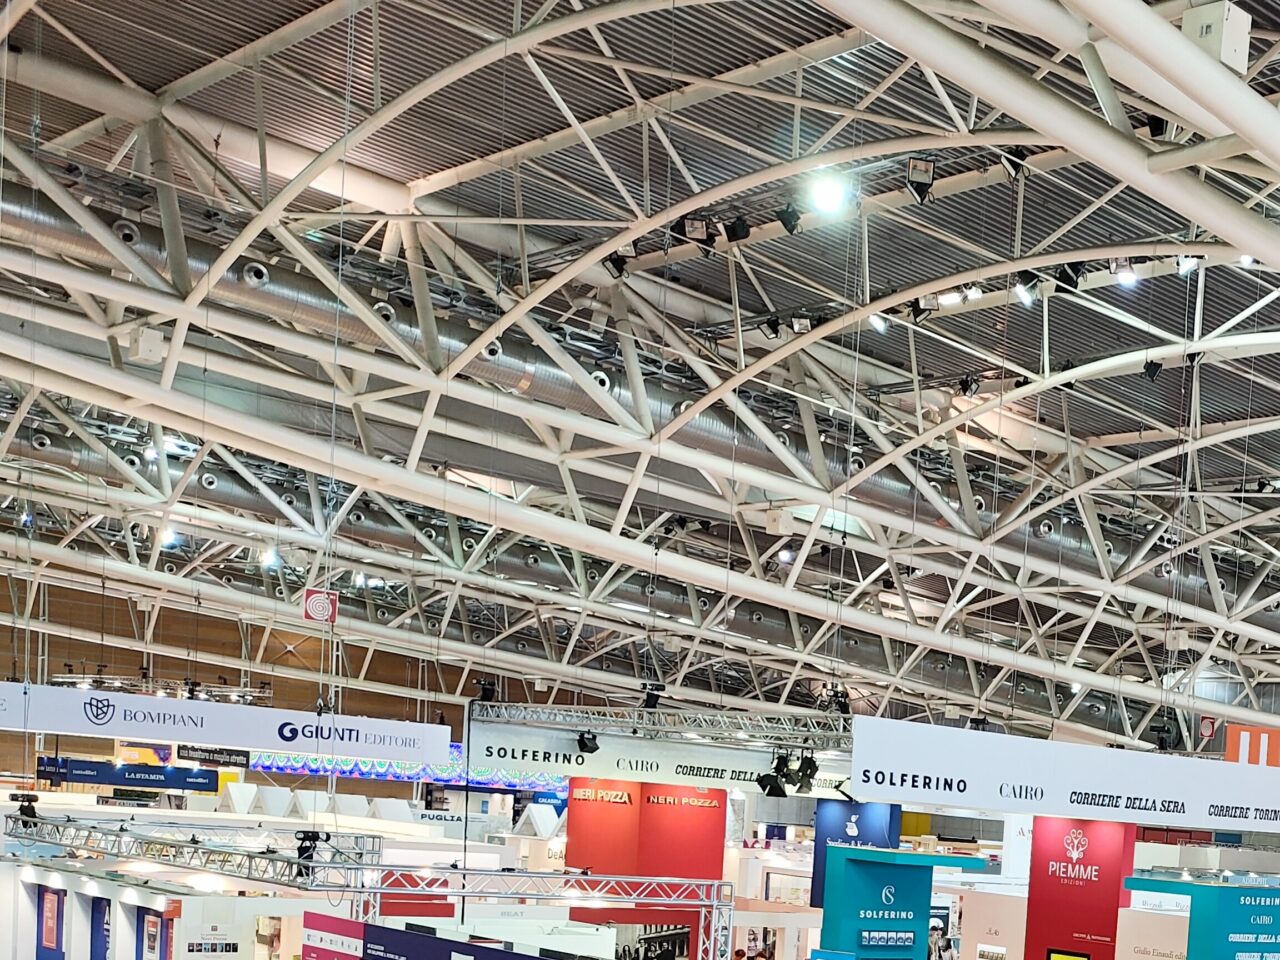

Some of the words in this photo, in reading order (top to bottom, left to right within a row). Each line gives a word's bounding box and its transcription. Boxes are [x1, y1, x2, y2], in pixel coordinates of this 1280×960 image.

[123, 708, 205, 729] BOMPIANI
[301, 724, 360, 743] GIUNTI
[364, 732, 421, 750] EDITORE
[485, 745, 585, 766] SOLFERINO
[616, 757, 660, 773] CAIRO
[675, 764, 726, 781] CORRIERE
[598, 790, 629, 803] POZZA
[862, 769, 967, 793] SOLFERINO
[999, 782, 1044, 802] CAIRO
[1070, 791, 1121, 809] CORRIERE
[1124, 796, 1156, 812] DELLA
[1160, 800, 1186, 814] SERA
[1208, 804, 1250, 819] CORRIERE
[650, 795, 679, 805] NERI
[681, 797, 720, 808] POZZA
[420, 812, 463, 823] PUGLIA
[1048, 861, 1100, 881] PIEMME
[1060, 879, 1086, 887] EDIZIONI
[859, 909, 914, 920] SOLFERINO
[1250, 915, 1273, 924] CAIRO
[1228, 934, 1256, 942] CORRIERE
[1257, 934, 1276, 943] DELLA
[1133, 946, 1151, 956] Giulio
[1152, 948, 1174, 959] Einaudi
